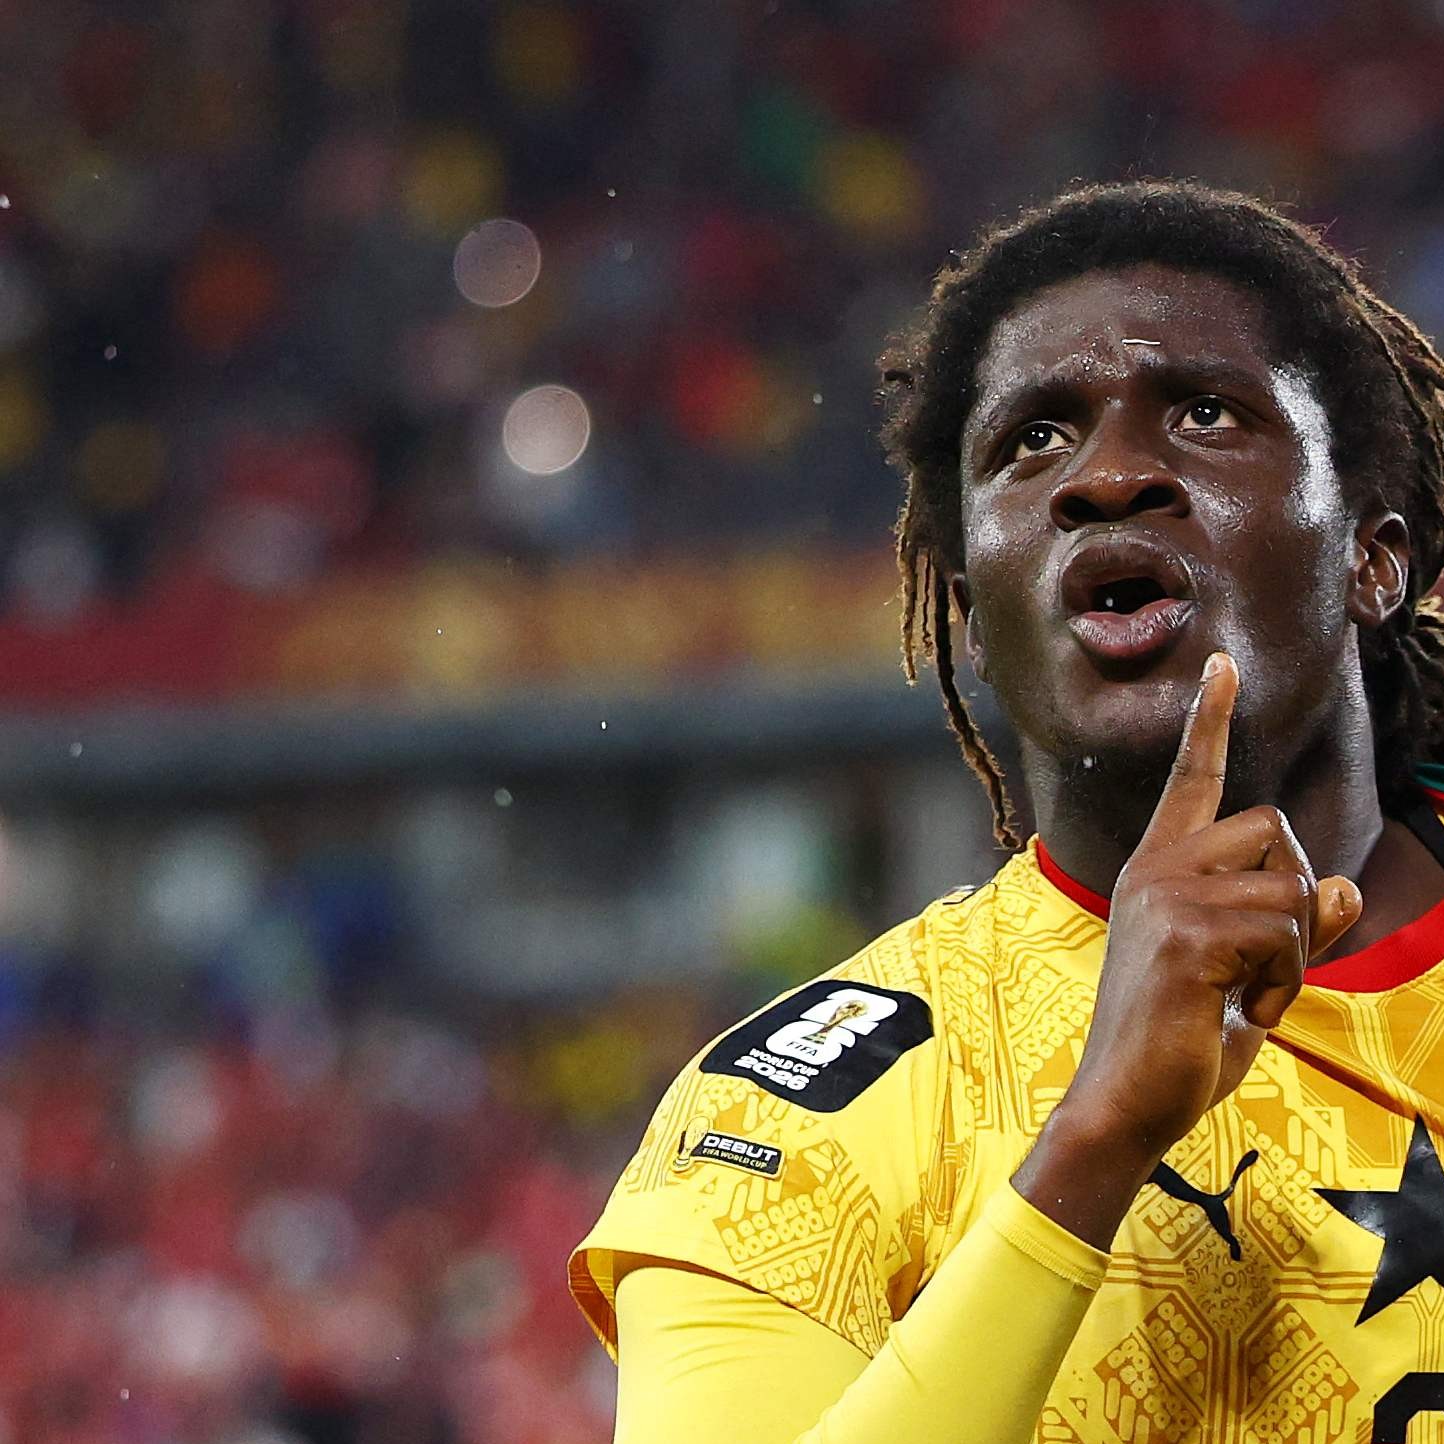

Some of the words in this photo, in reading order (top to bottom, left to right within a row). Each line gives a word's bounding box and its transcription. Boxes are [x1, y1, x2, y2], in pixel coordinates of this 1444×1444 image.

[786, 1041, 818, 1057] FIFA
[733, 1055, 810, 1090] 2026
[749, 1048, 794, 1070] WORLD
[792, 1063, 820, 1077] CUP
[702, 1147, 720, 1157] FIFA
[720, 1150, 750, 1164] WORLD
[749, 1158, 768, 1169] CUP
[703, 1135, 778, 1161] DEBUT
